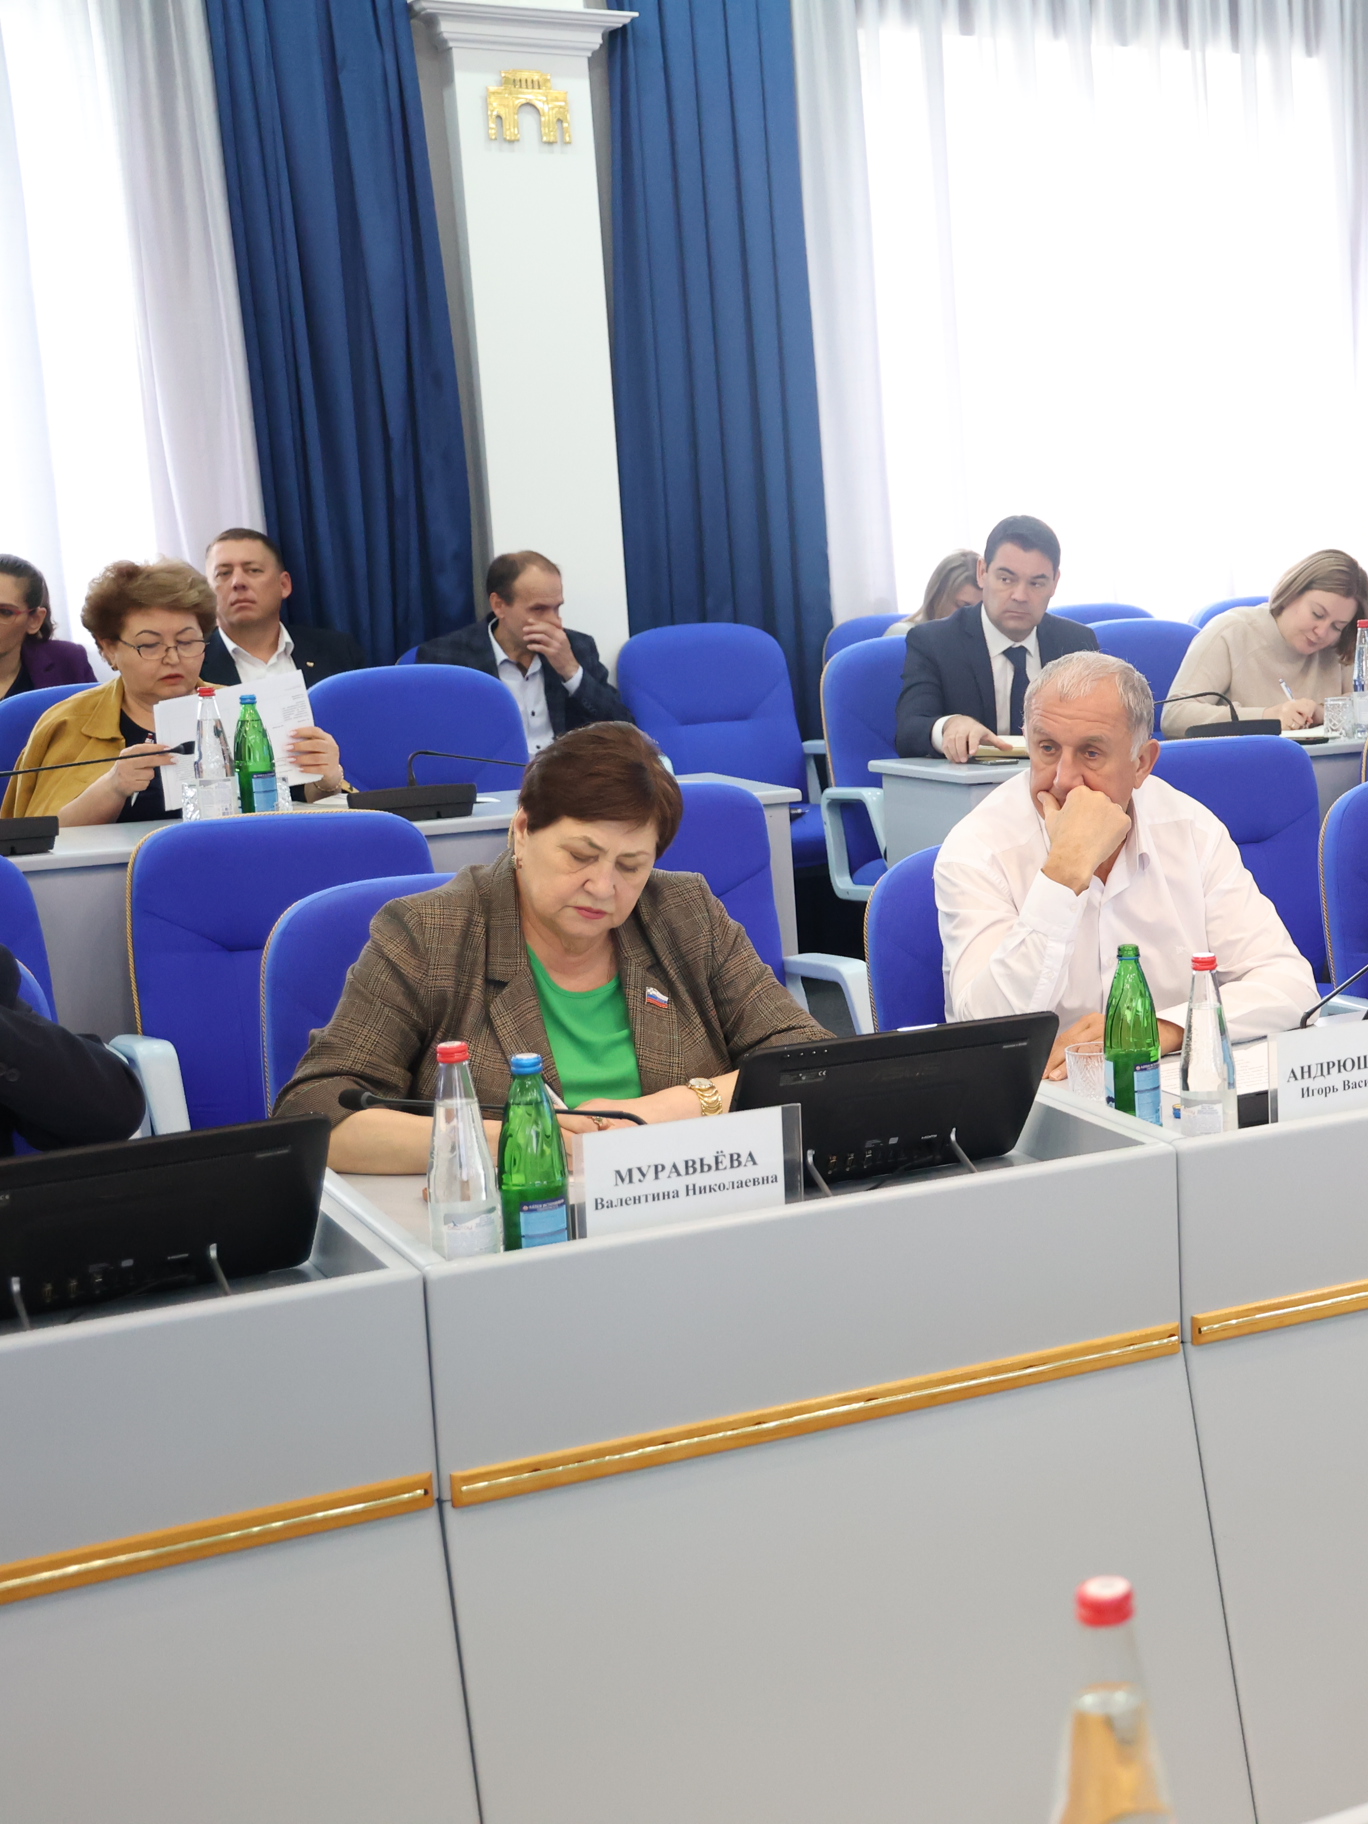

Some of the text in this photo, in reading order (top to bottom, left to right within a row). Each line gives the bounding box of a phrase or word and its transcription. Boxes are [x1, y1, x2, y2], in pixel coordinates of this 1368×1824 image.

[1300, 1084, 1339, 1099] Игорь
[613, 1150, 759, 1187] МУРАВЬЁВА
[593, 1188, 680, 1211] Валентина
[684, 1173, 779, 1197] Николаевна
